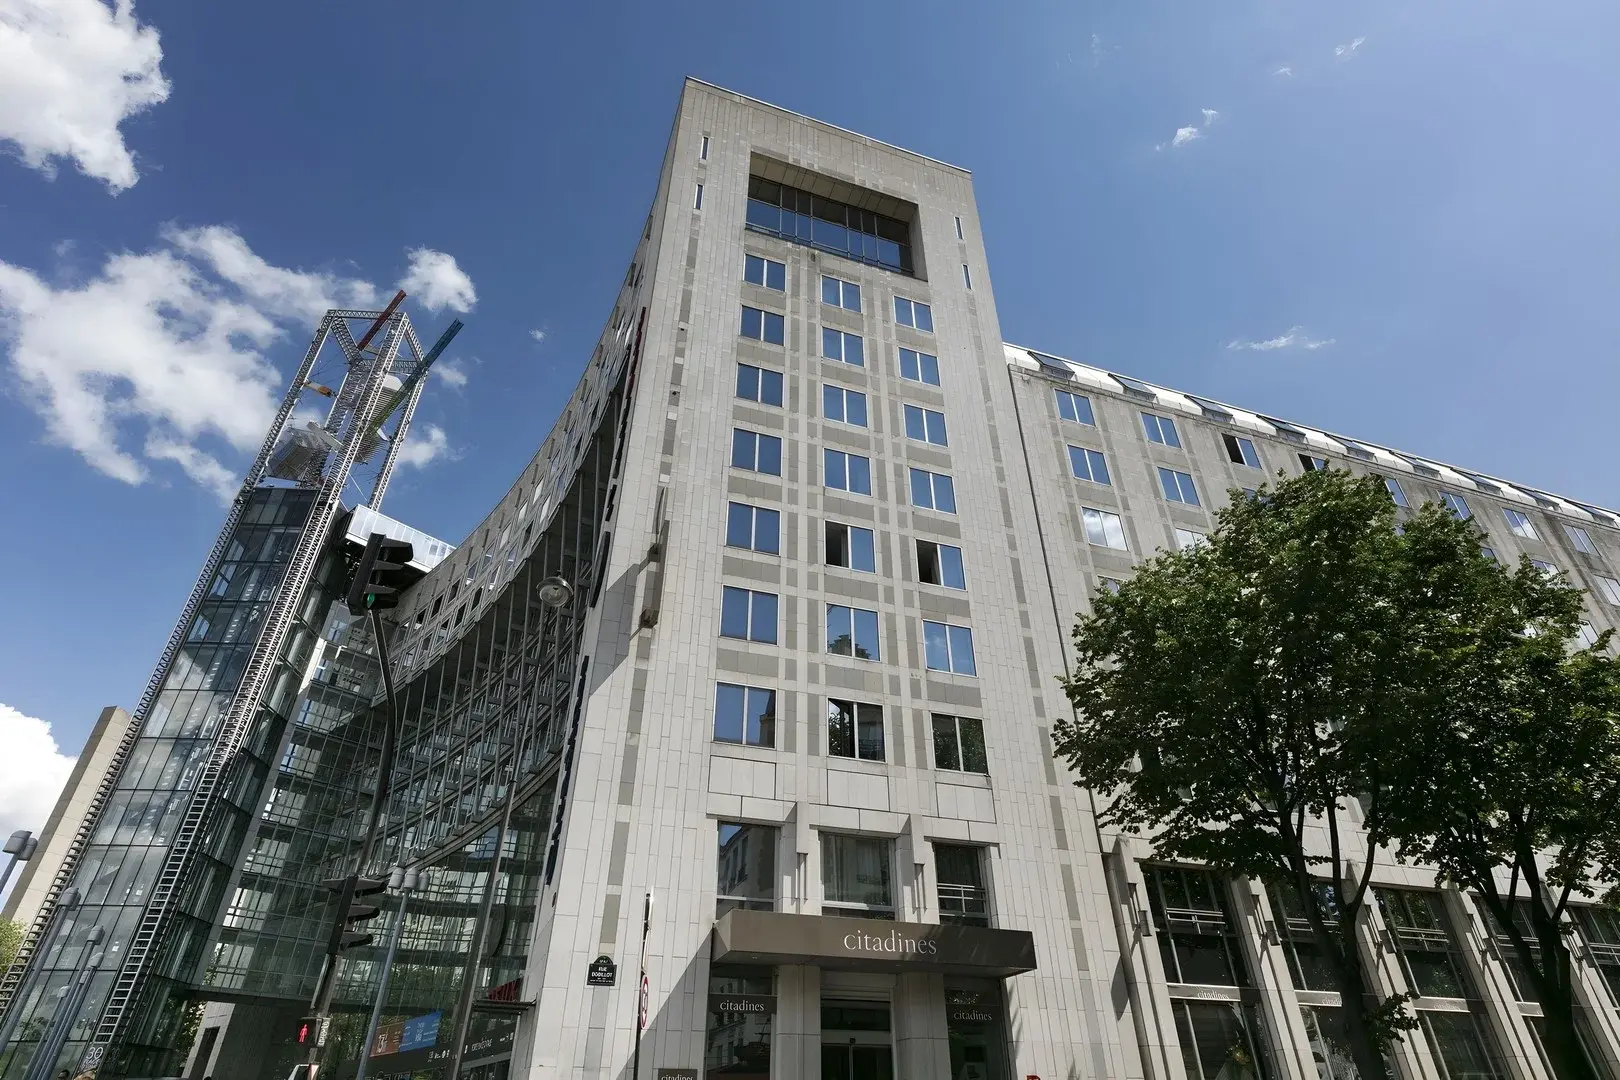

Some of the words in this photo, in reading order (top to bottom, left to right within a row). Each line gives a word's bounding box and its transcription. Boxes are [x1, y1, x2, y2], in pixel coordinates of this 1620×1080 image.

[843, 929, 938, 955] citadines
[719, 999, 765, 1012] citadines
[953, 1009, 992, 1021] citadines
[86, 1046, 104, 1060] 30
